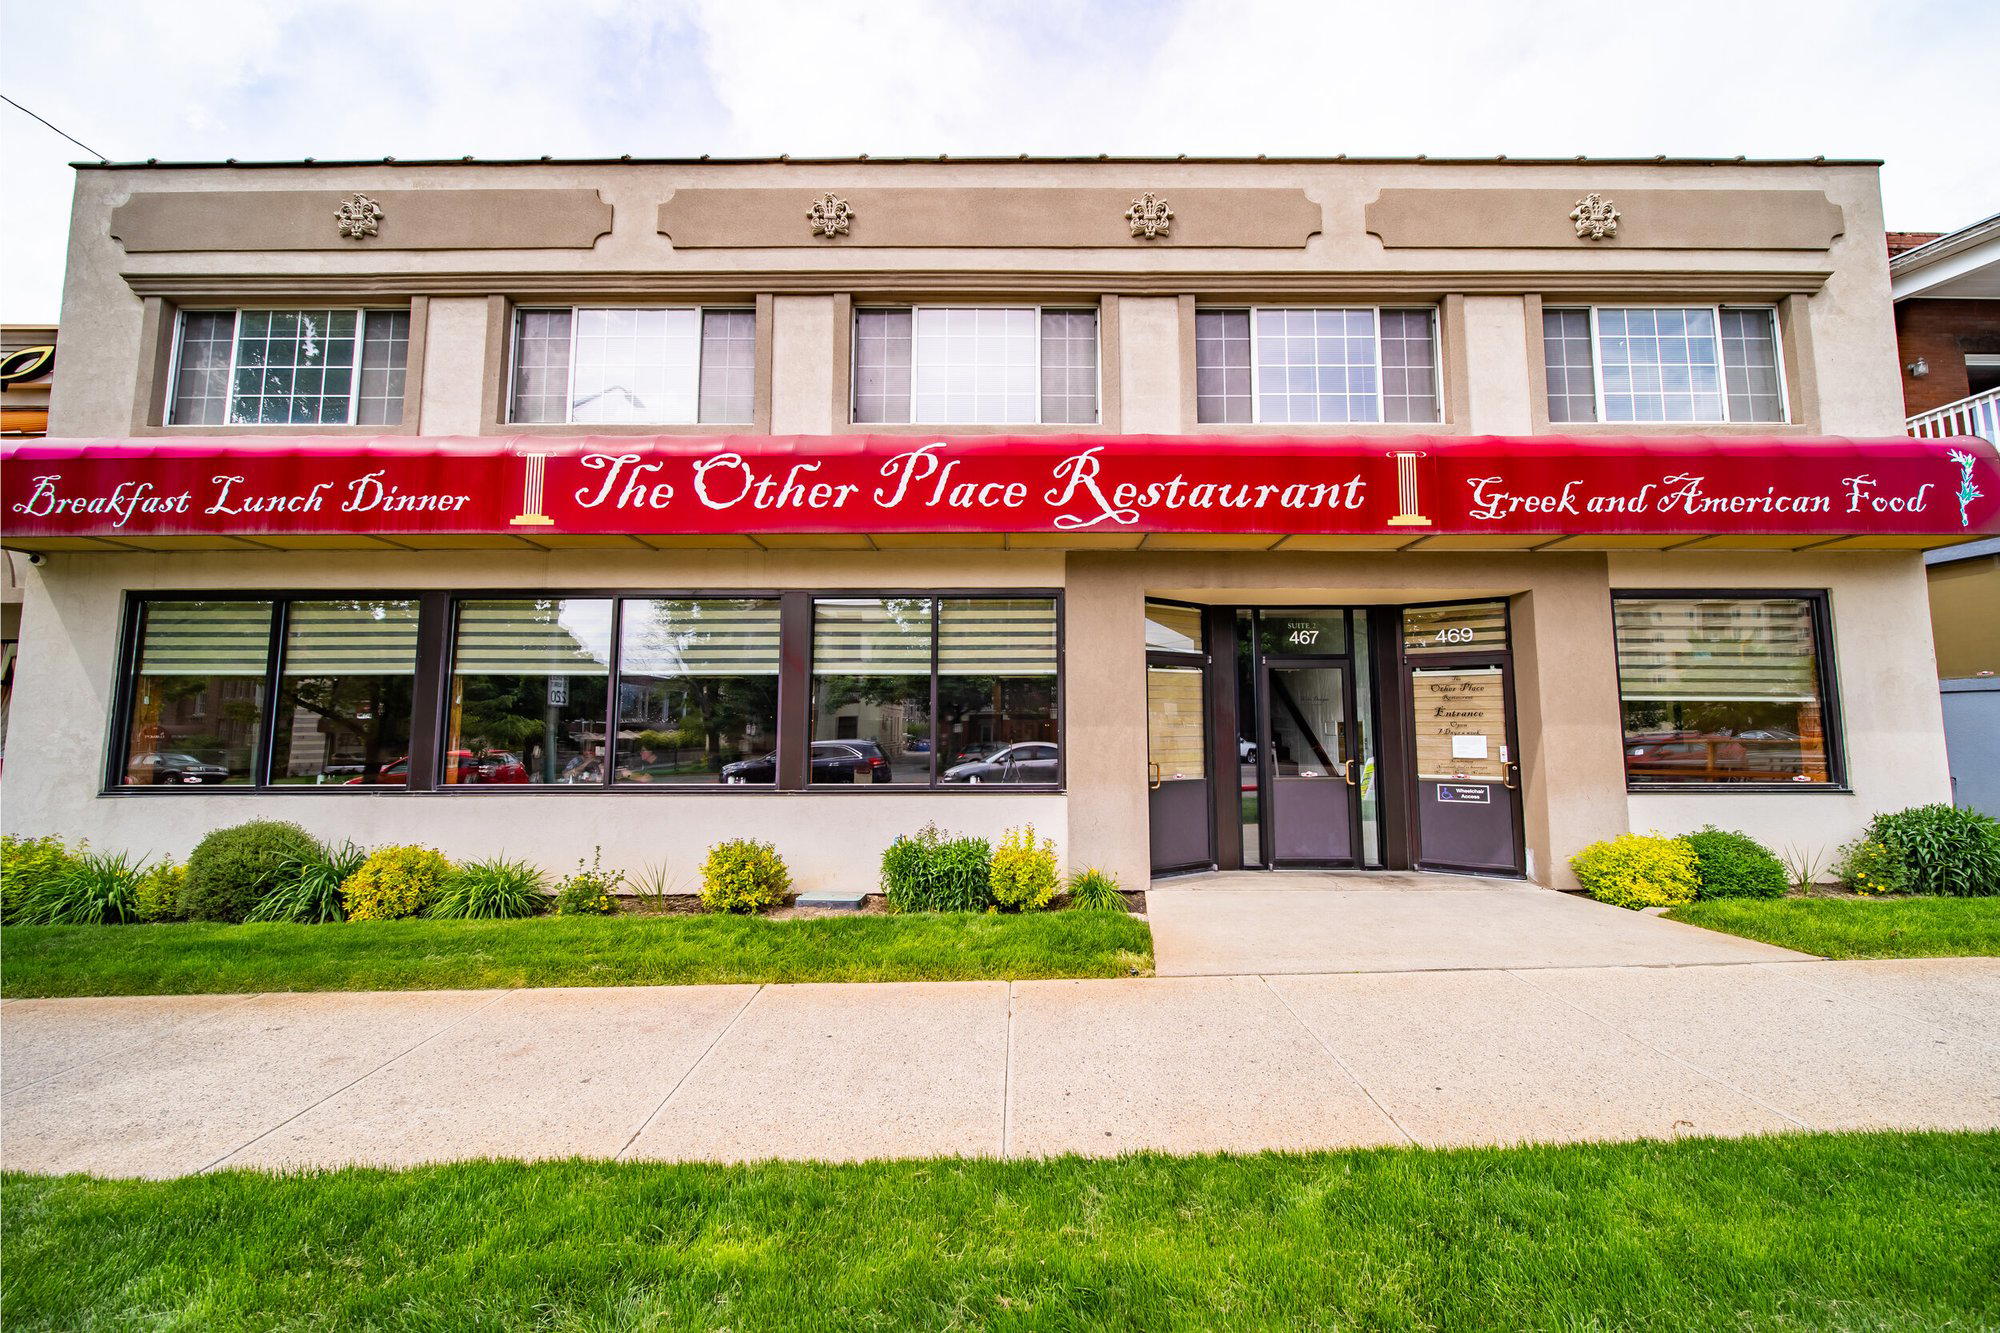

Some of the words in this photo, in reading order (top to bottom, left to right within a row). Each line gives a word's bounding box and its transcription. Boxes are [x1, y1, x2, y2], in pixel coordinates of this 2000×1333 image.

[574, 452, 674, 510] The
[692, 452, 859, 511] Other
[873, 441, 1028, 509] Place
[1043, 445, 1367, 530] Restaurant
[12, 474, 191, 528] Breakfast
[204, 475, 333, 515] Lunch
[341, 469, 471, 513] Dinner
[1466, 476, 1584, 520] Greek
[1586, 483, 1657, 513] and
[1656, 472, 1831, 515] American
[1841, 473, 1935, 514] Food
[1289, 630, 1319, 645] 467
[1434, 627, 1474, 643] 469
[1430, 683, 1456, 692] Other
[1459, 682, 1485, 692] Place
[1433, 706, 1484, 717] Entrance
